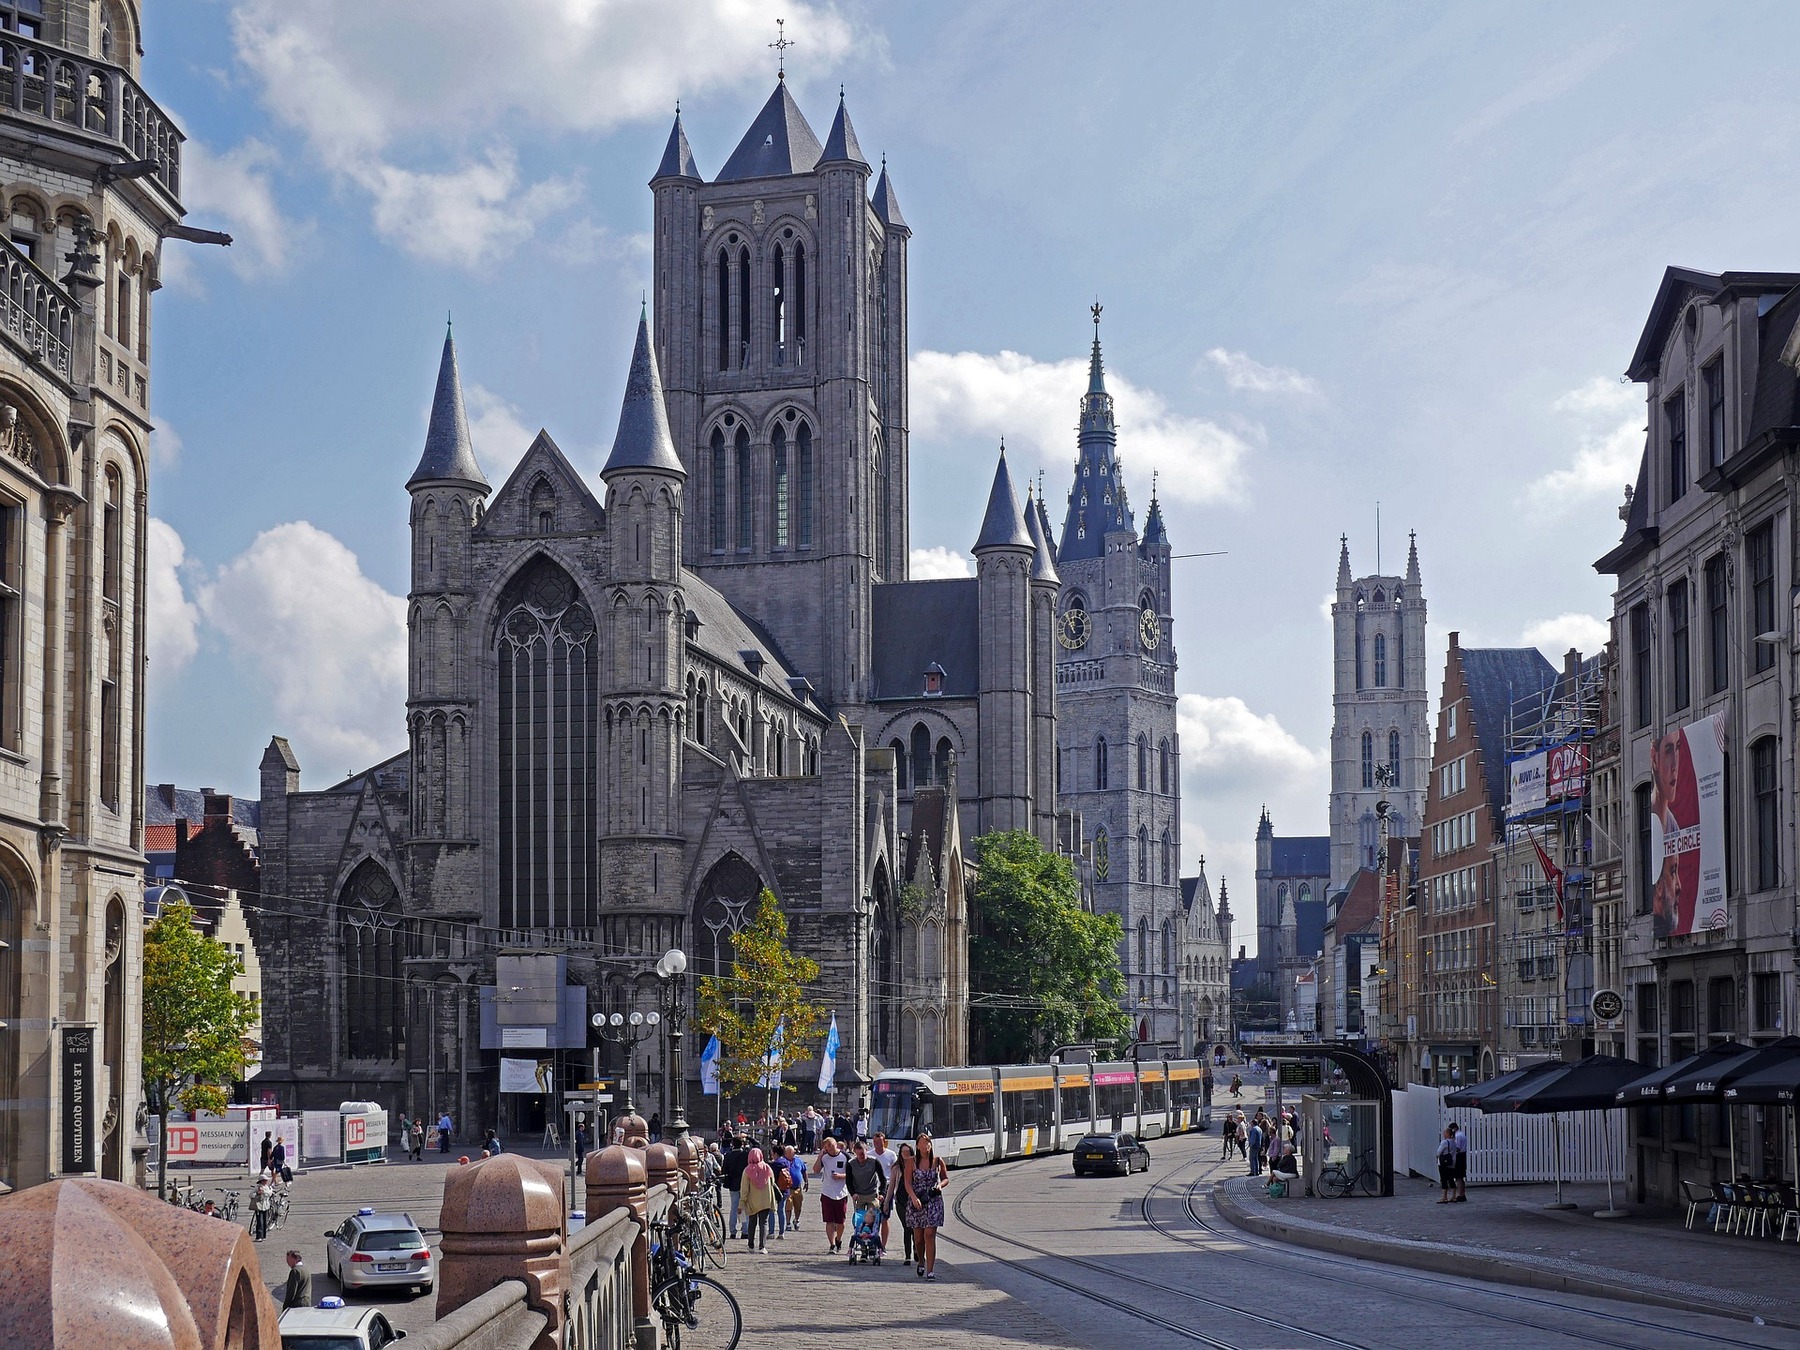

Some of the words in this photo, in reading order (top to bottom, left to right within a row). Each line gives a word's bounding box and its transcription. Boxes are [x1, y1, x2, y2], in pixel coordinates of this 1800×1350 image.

[1664, 839, 1676, 856] THE
[1677, 832, 1700, 852] CIRCLE
[74, 1063, 82, 1076] LE
[74, 1079, 82, 1103] PAIN
[959, 1083, 970, 1092] DEBA
[971, 1081, 993, 1091] MEUBELEN
[73, 1105, 82, 1163] QUOTIDIEN
[201, 1142, 244, 1150] messiaen.pro
